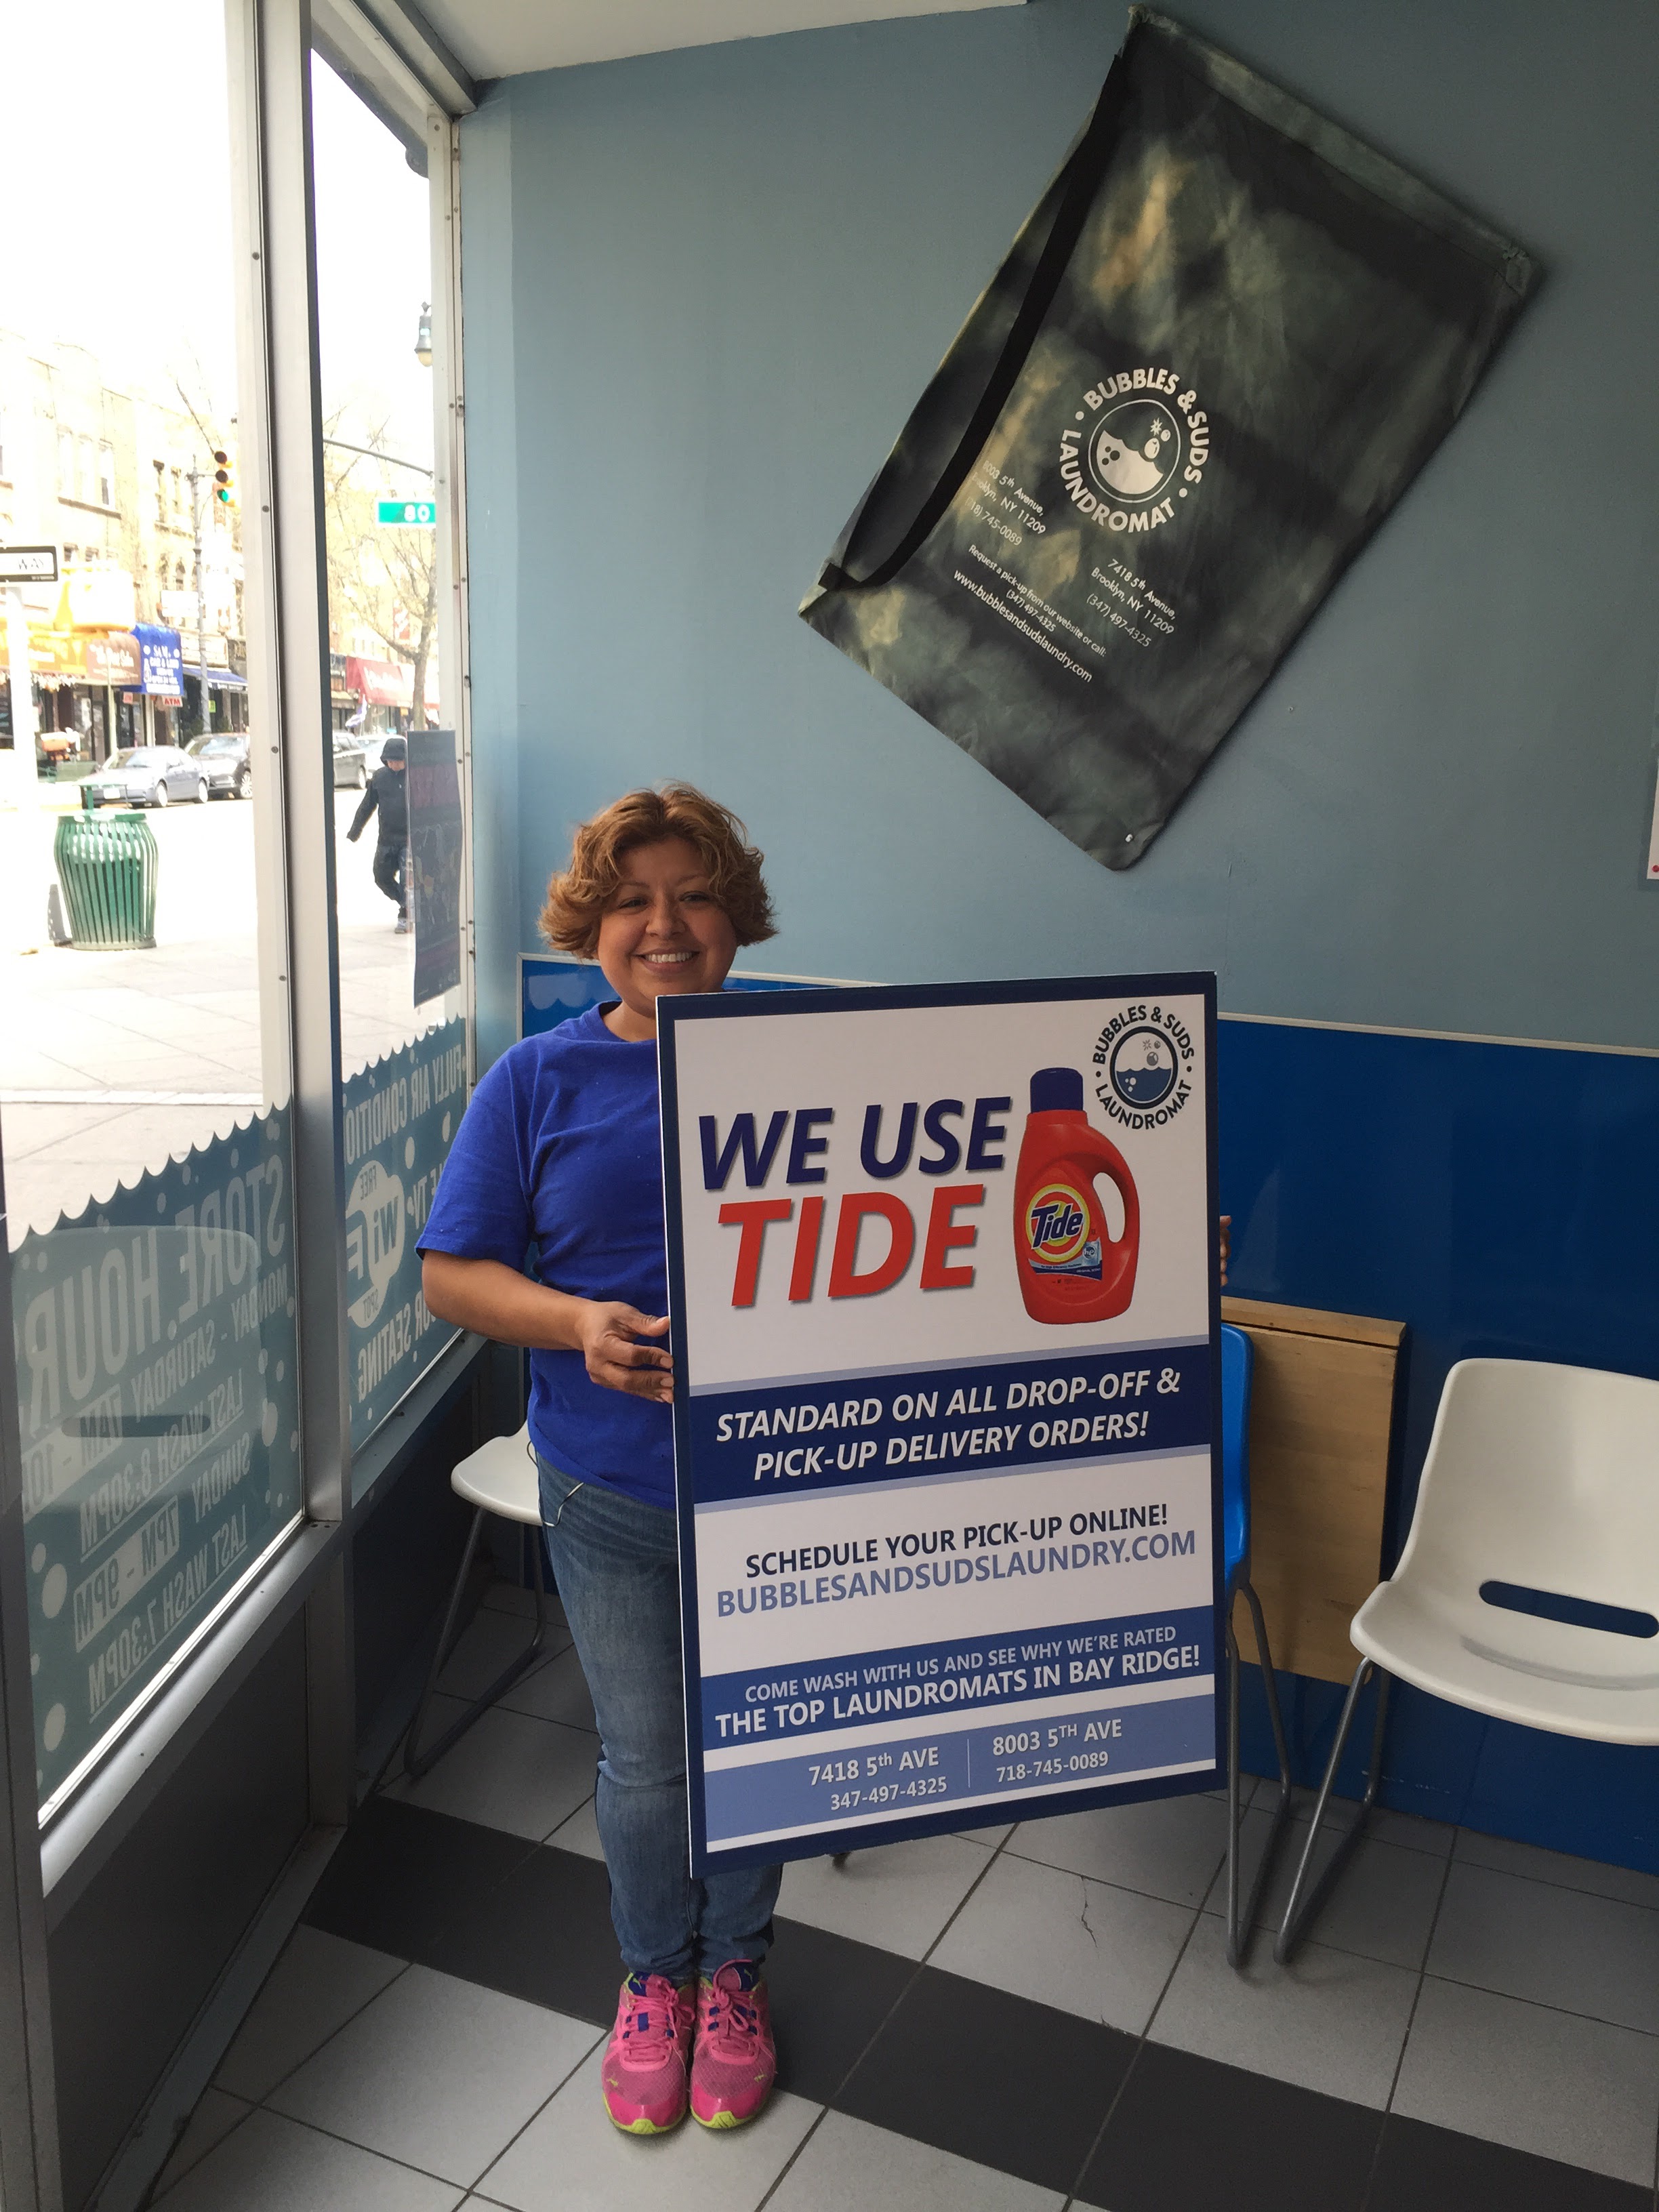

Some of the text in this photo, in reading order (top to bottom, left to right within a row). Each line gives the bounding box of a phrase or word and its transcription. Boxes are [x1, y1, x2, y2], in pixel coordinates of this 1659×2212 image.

[1083, 367, 1210, 485] BUBBLES & SUDS
[999, 475, 1015, 488] 5th
[1014, 487, 1044, 516] Avenue,
[1059, 429, 1175, 533] LAUNDROMAT
[404, 504, 430, 523] 80
[982, 511, 1023, 546] 745-0089
[1000, 497, 1018, 513] NY
[1017, 509, 1046, 535] 11209
[968, 544, 998, 571] Request
[1000, 571, 1028, 596] pick-up
[1026, 590, 1044, 608] from
[1043, 604, 1057, 618] our
[1056, 613, 1084, 639] website
[1082, 636, 1092, 646] or
[1090, 642, 1107, 657] call:
[1006, 589, 1057, 632] (347) 497-4325
[1091, 567, 1174, 634] Brooklyn, NY 11209
[1107, 558, 1176, 620] 7418 5th Avenue,
[954, 570, 1093, 682] www.bubblesandsudslaundry.com
[1086, 593, 1151, 647] (347) 497-4325
[164, 697, 181, 706] ATM
[1092, 1005, 1194, 1064] BUBBLES & SUDS
[1095, 1080, 1191, 1130] LAUNDROMAT
[698, 1096, 1012, 1191] WE USE
[718, 1184, 985, 1307] TIDE
[1031, 1203, 1084, 1250] Tide
[716, 1367, 1181, 1441] STANDARD ON ALL DROP-OFF &
[754, 1411, 1149, 1480] PICK-UP DELIVERY ORDERS!
[746, 1503, 1168, 1578] SCHEDULE YOUR PICK-UP ONLINE!
[716, 1530, 1196, 1618] BUBBLESANDSUDSLAUNDRY.COM
[716, 1644, 1200, 1738] THE TOP LAUNDROMATS IN BAY RIDGE!
[745, 1626, 1176, 1702] COME WASH WITH US AND SEE WHY WE'RE RATED
[808, 1746, 939, 1787] 7418 5th AVE
[992, 1719, 1123, 1757] 8003 5TH AVE
[996, 1750, 1109, 1782] 718-745-0089
[830, 1775, 948, 1811] 347-497-4325
